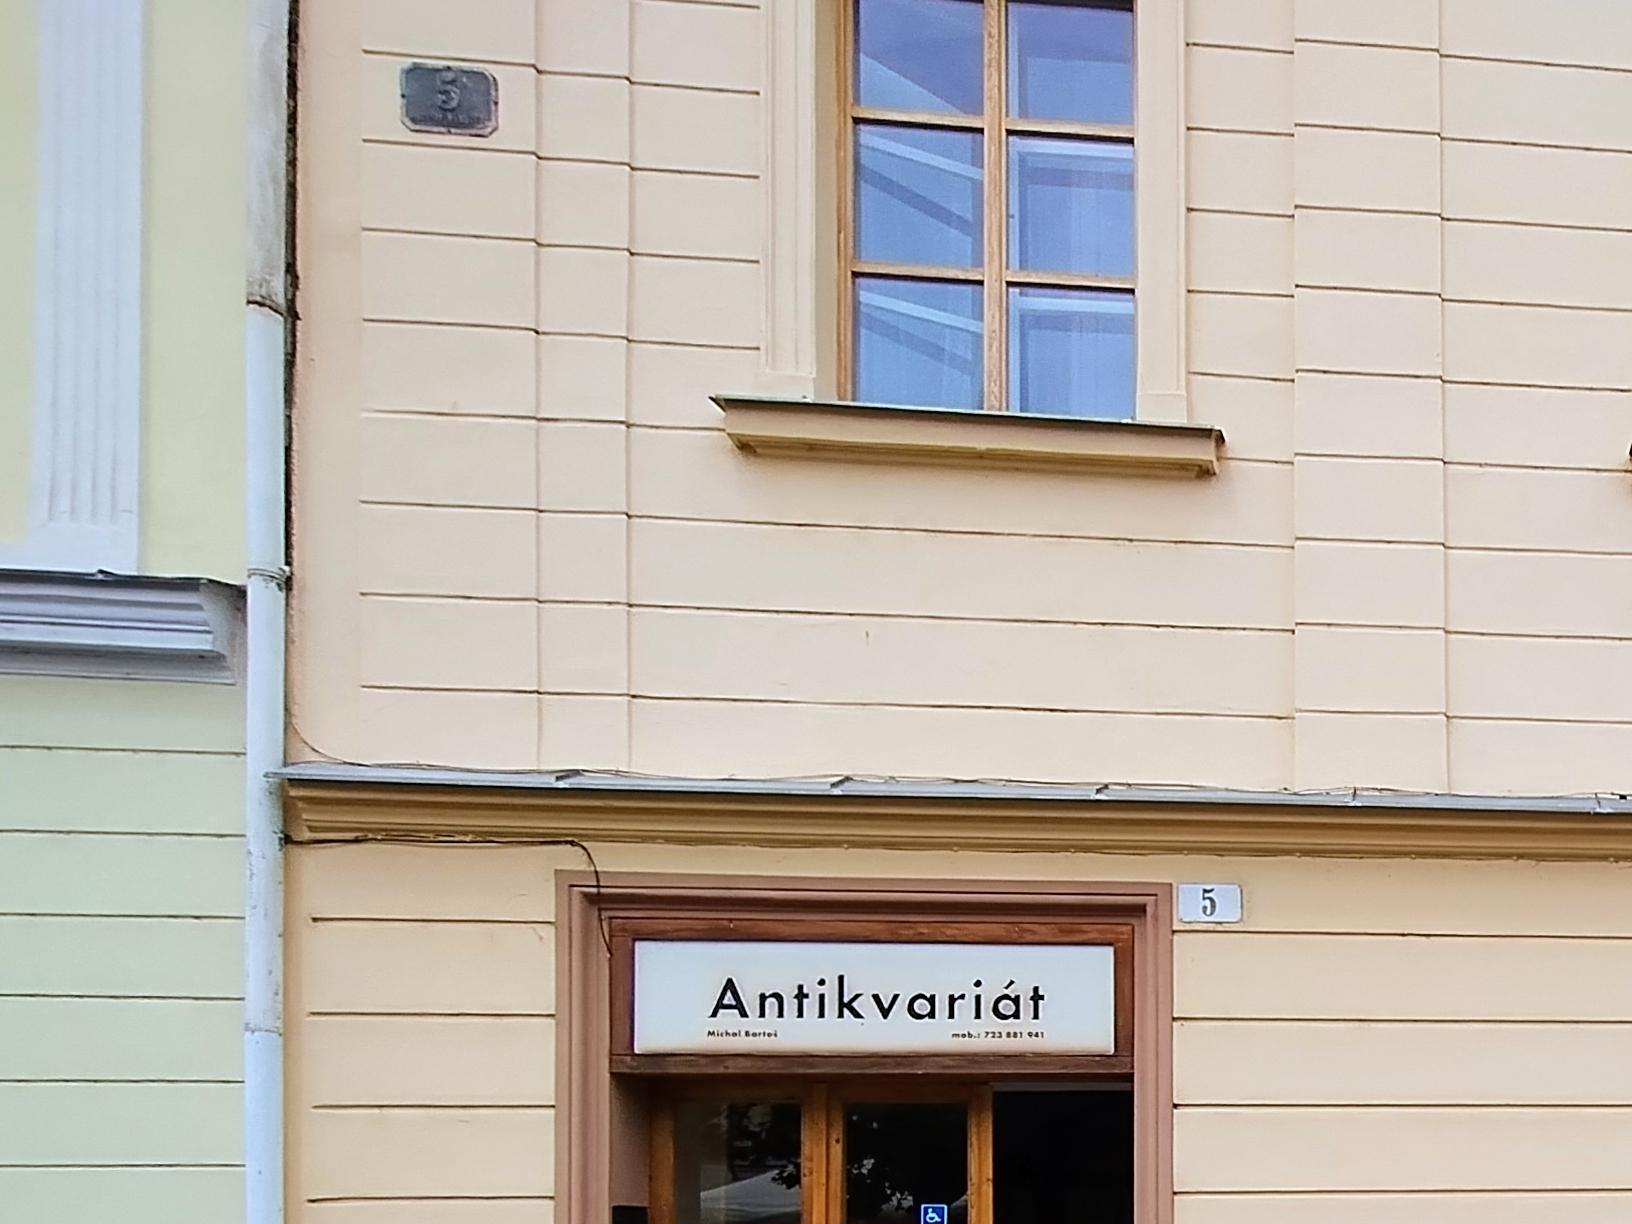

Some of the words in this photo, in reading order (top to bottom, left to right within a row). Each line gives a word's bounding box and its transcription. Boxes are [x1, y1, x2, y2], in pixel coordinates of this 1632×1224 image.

[1202, 888, 1217, 917] 5
[708, 974, 1046, 1021] Antikvariát
[707, 1030, 741, 1038] Michal
[984, 1031, 1003, 1039] 723
[1005, 1031, 1023, 1039] 881
[1027, 1031, 1045, 1039] 941
